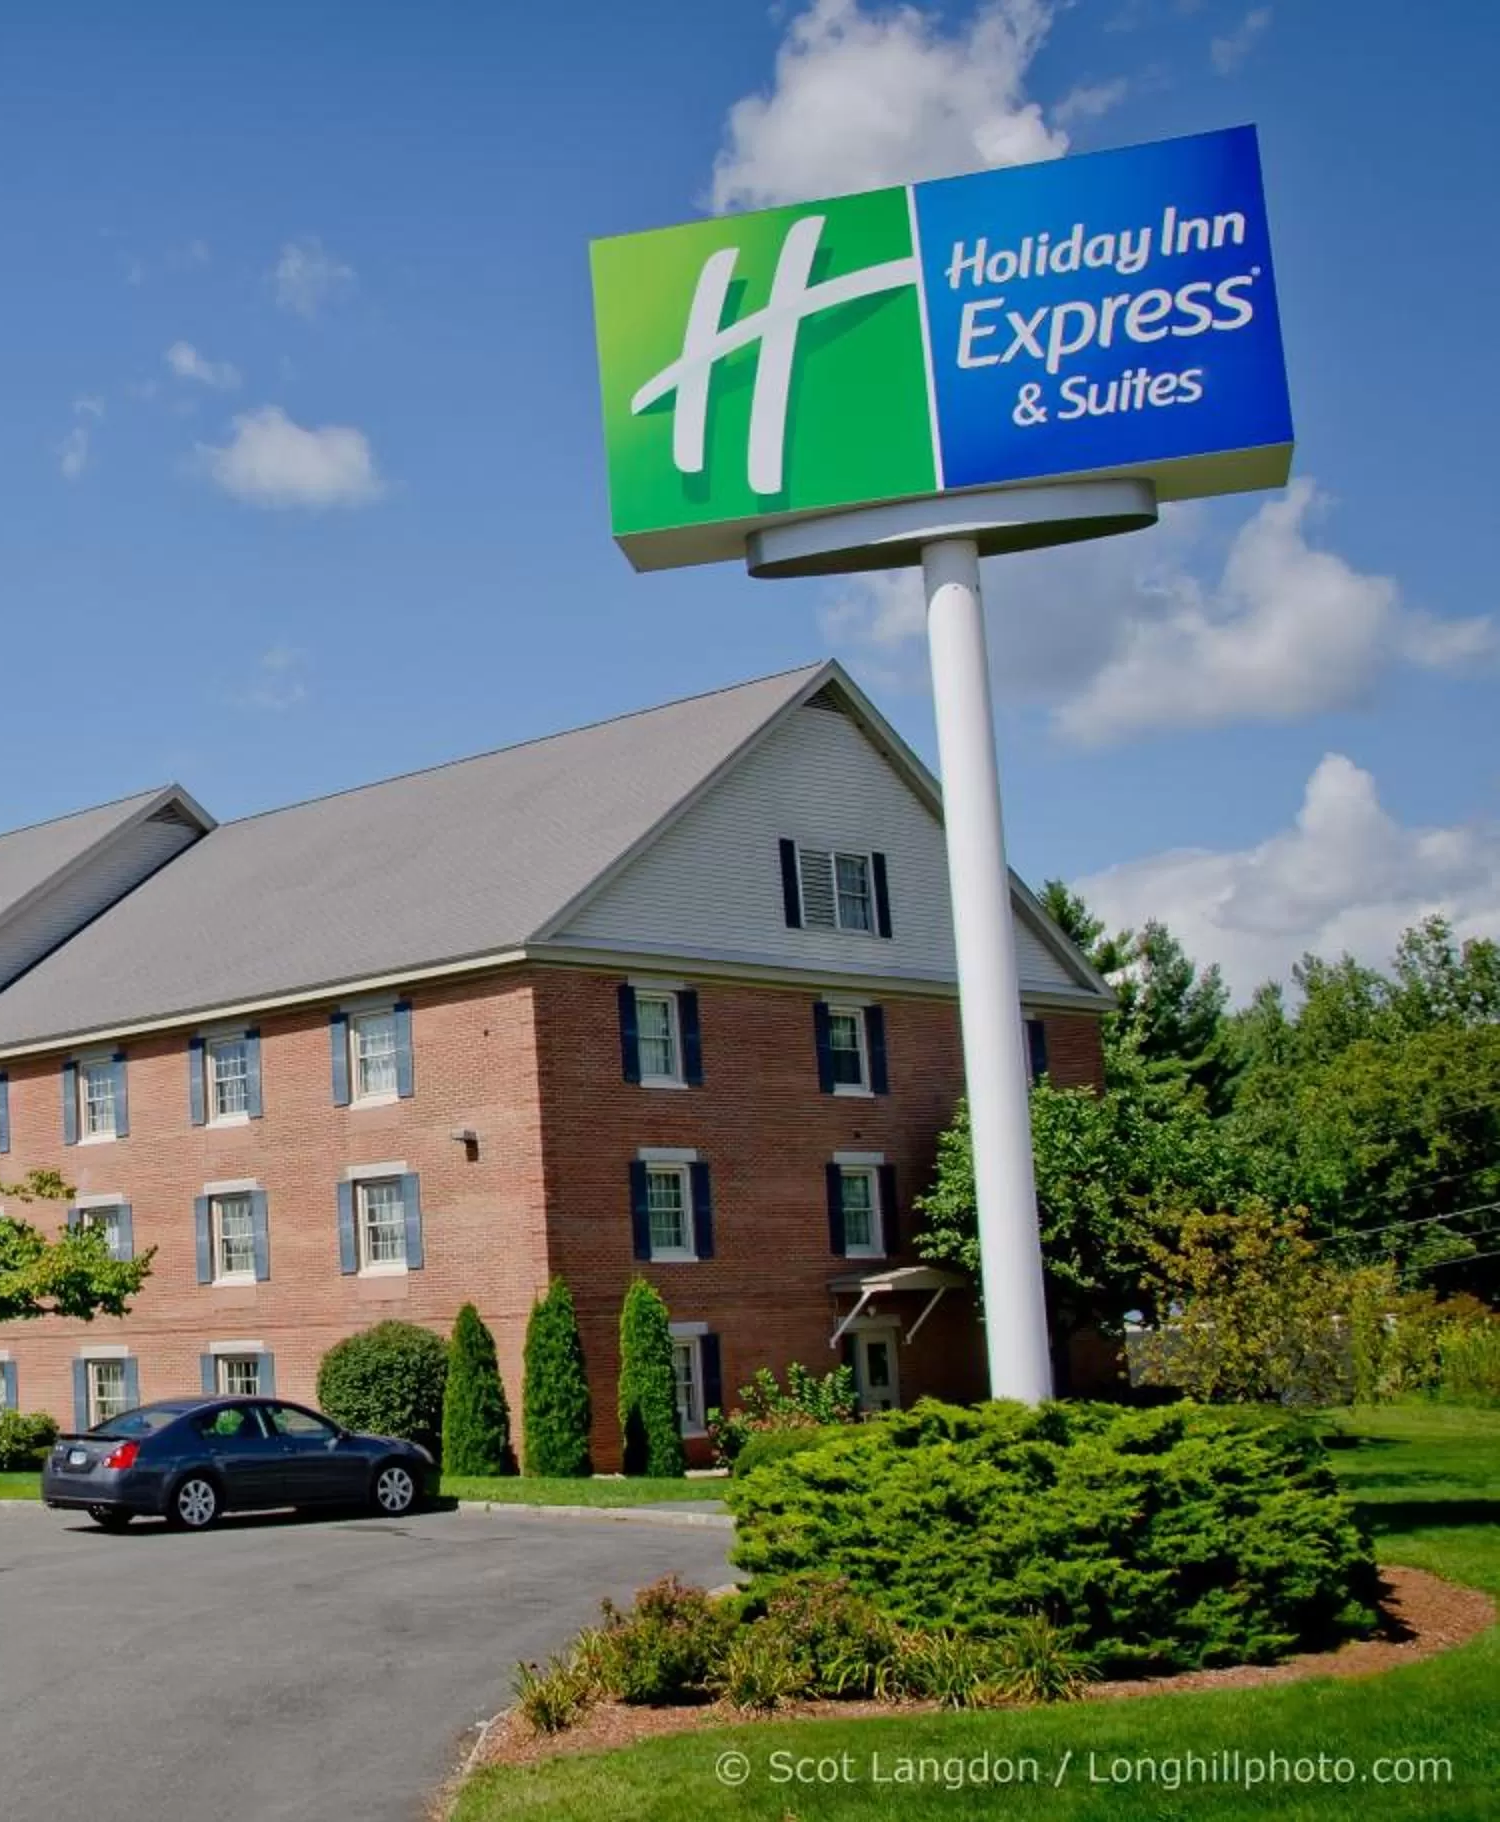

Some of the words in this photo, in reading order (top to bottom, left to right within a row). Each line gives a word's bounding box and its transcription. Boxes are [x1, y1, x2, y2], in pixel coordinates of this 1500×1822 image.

[944, 223, 1152, 289] Holiday
[1161, 206, 1246, 256] Inn
[631, 215, 916, 495] H
[956, 274, 1255, 375] Express
[1012, 382, 1048, 426] &
[1057, 367, 1204, 420] Suites
